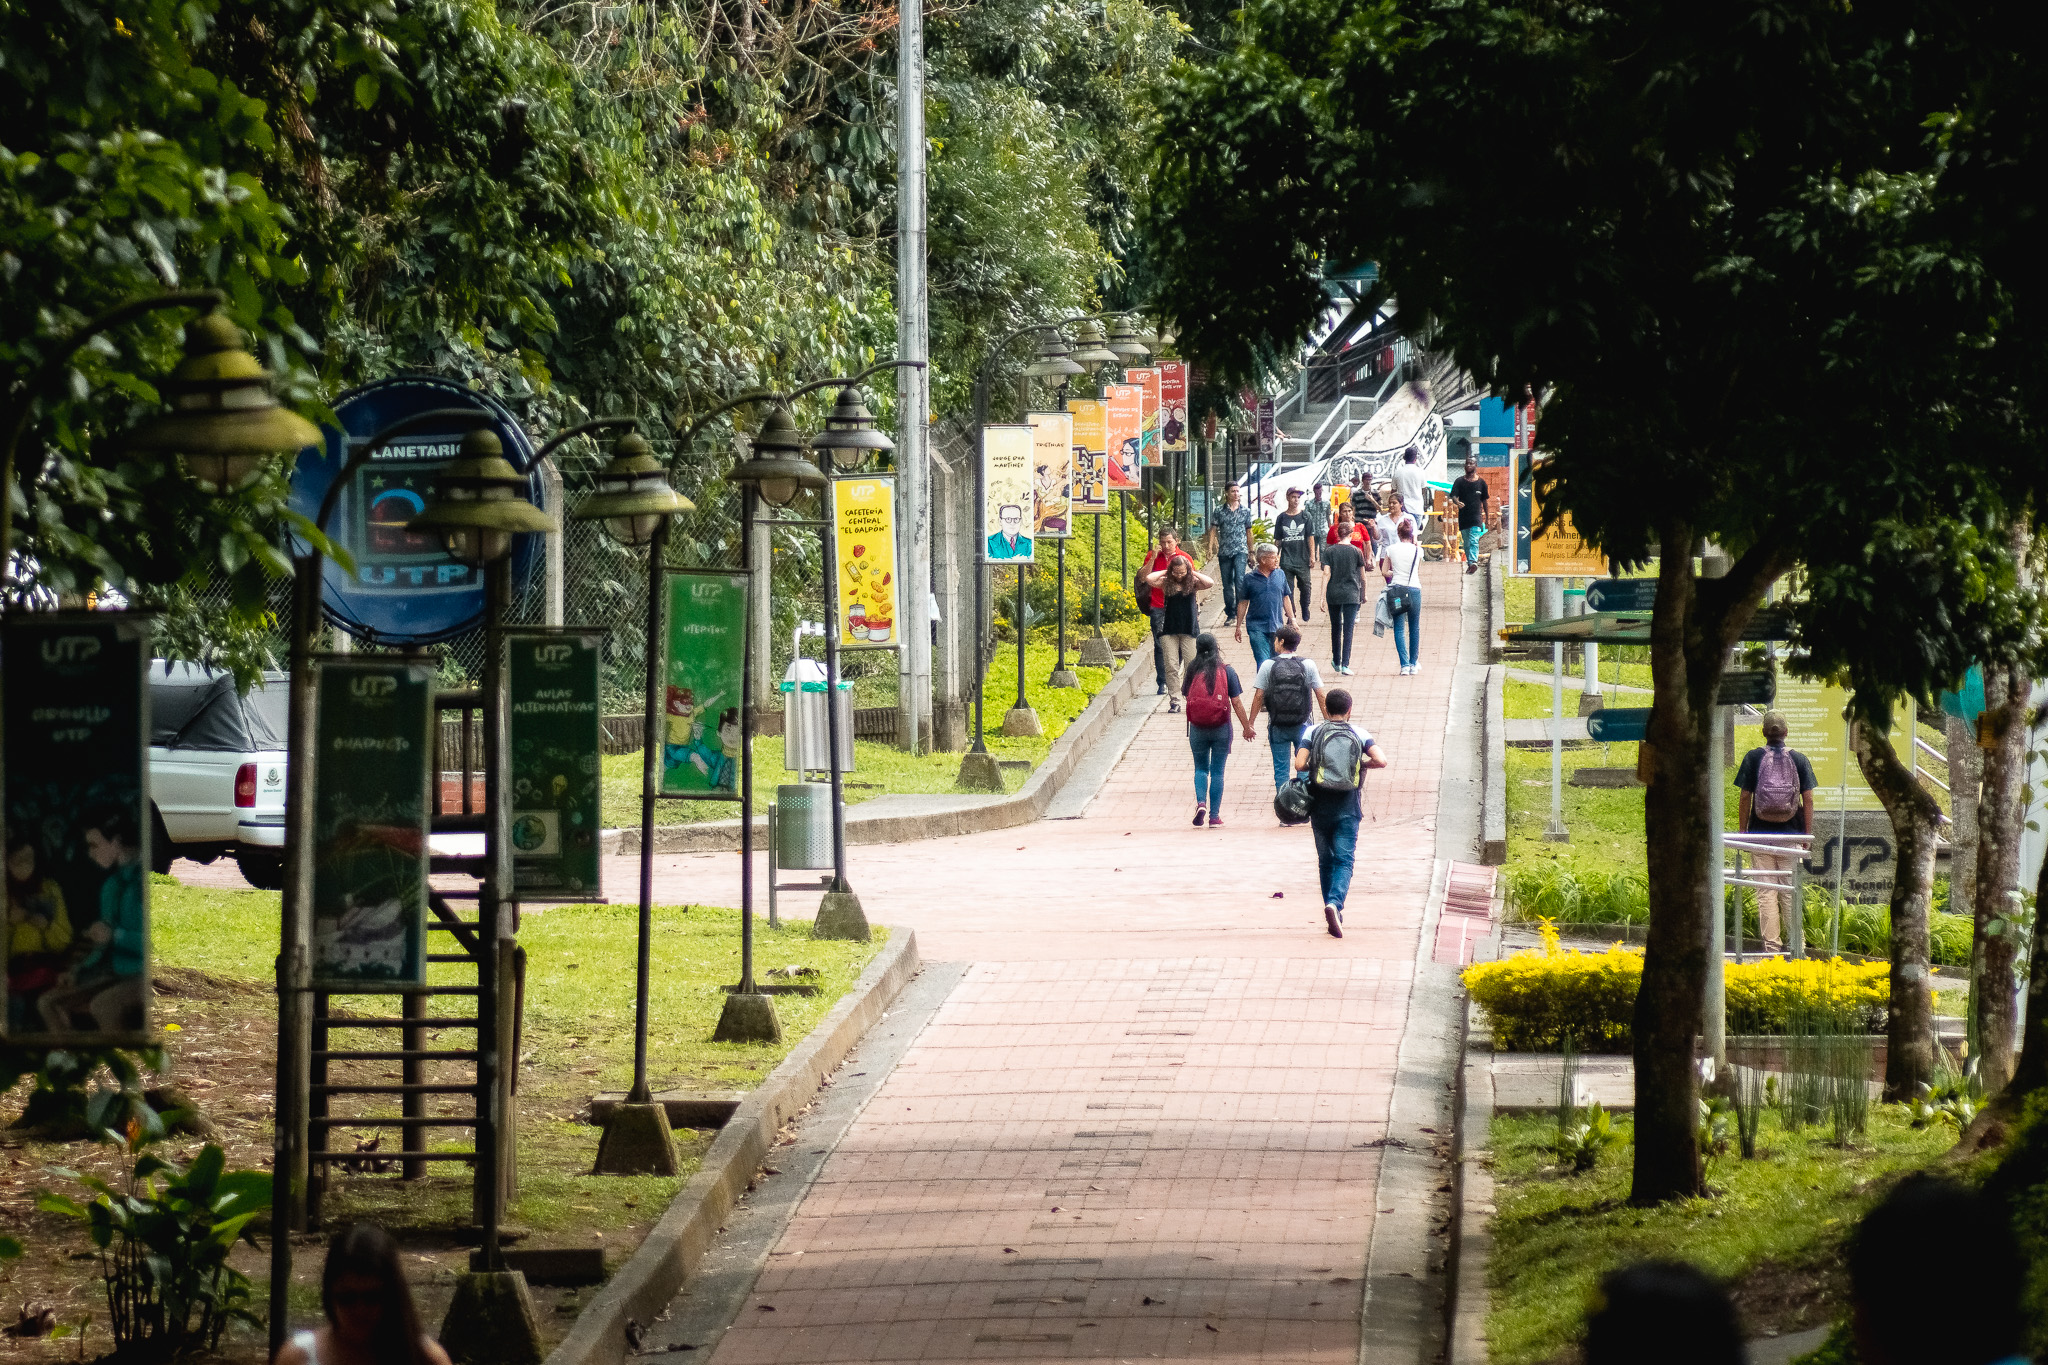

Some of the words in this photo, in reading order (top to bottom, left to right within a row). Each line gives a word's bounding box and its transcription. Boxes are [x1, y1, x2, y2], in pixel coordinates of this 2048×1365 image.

[1136, 372, 1151, 380] UTP
[1115, 389, 1131, 398] UTP
[1079, 404, 1096, 413] UTP
[1041, 419, 1059, 429] UTP
[851, 485, 876, 497] UTP
[849, 516, 882, 525] CENTRAL
[1546, 542, 1564, 550] Water
[1565, 542, 1577, 550] and
[1540, 552, 1566, 561] Analysis
[359, 565, 469, 585] UTP
[691, 583, 723, 598] UTP
[40, 635, 102, 663] UTP
[534, 644, 574, 663] UTP
[350, 675, 398, 697] UTP
[535, 689, 574, 700] AULAS
[513, 701, 596, 714] ALTERNATIVAS
[1802, 836, 1892, 875] UTP
[1849, 879, 1893, 890] Tecnoló
